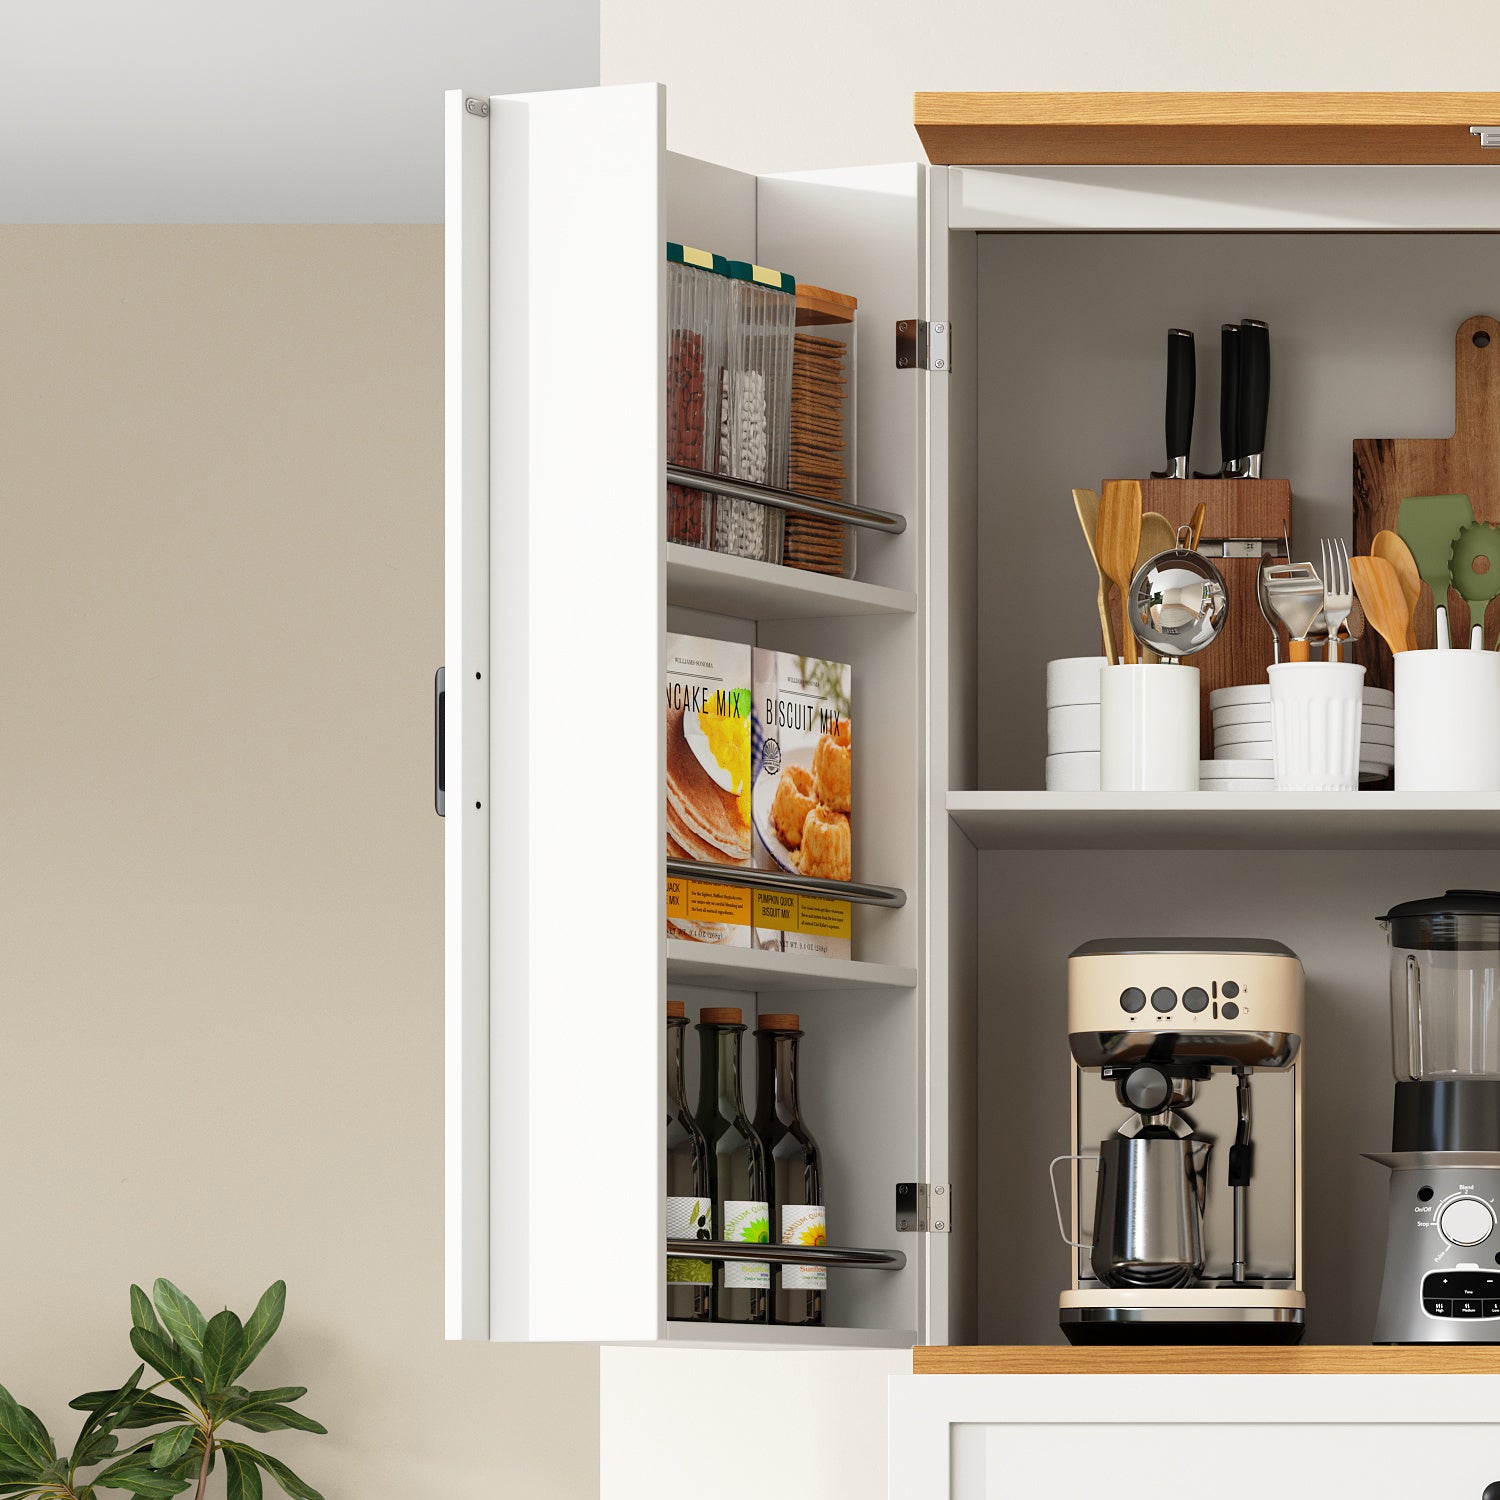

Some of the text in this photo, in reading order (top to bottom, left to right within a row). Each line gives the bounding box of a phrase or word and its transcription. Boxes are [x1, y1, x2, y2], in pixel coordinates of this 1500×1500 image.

[716, 690, 740, 718] MIX
[766, 699, 840, 736] BISCUIT MIX
[669, 896, 680, 906] MIX
[758, 893, 779, 905] PUMPKIN
[780, 897, 794, 907] QUICK
[762, 906, 781, 918] BISCUIT
[781, 910, 791, 919] MIX
